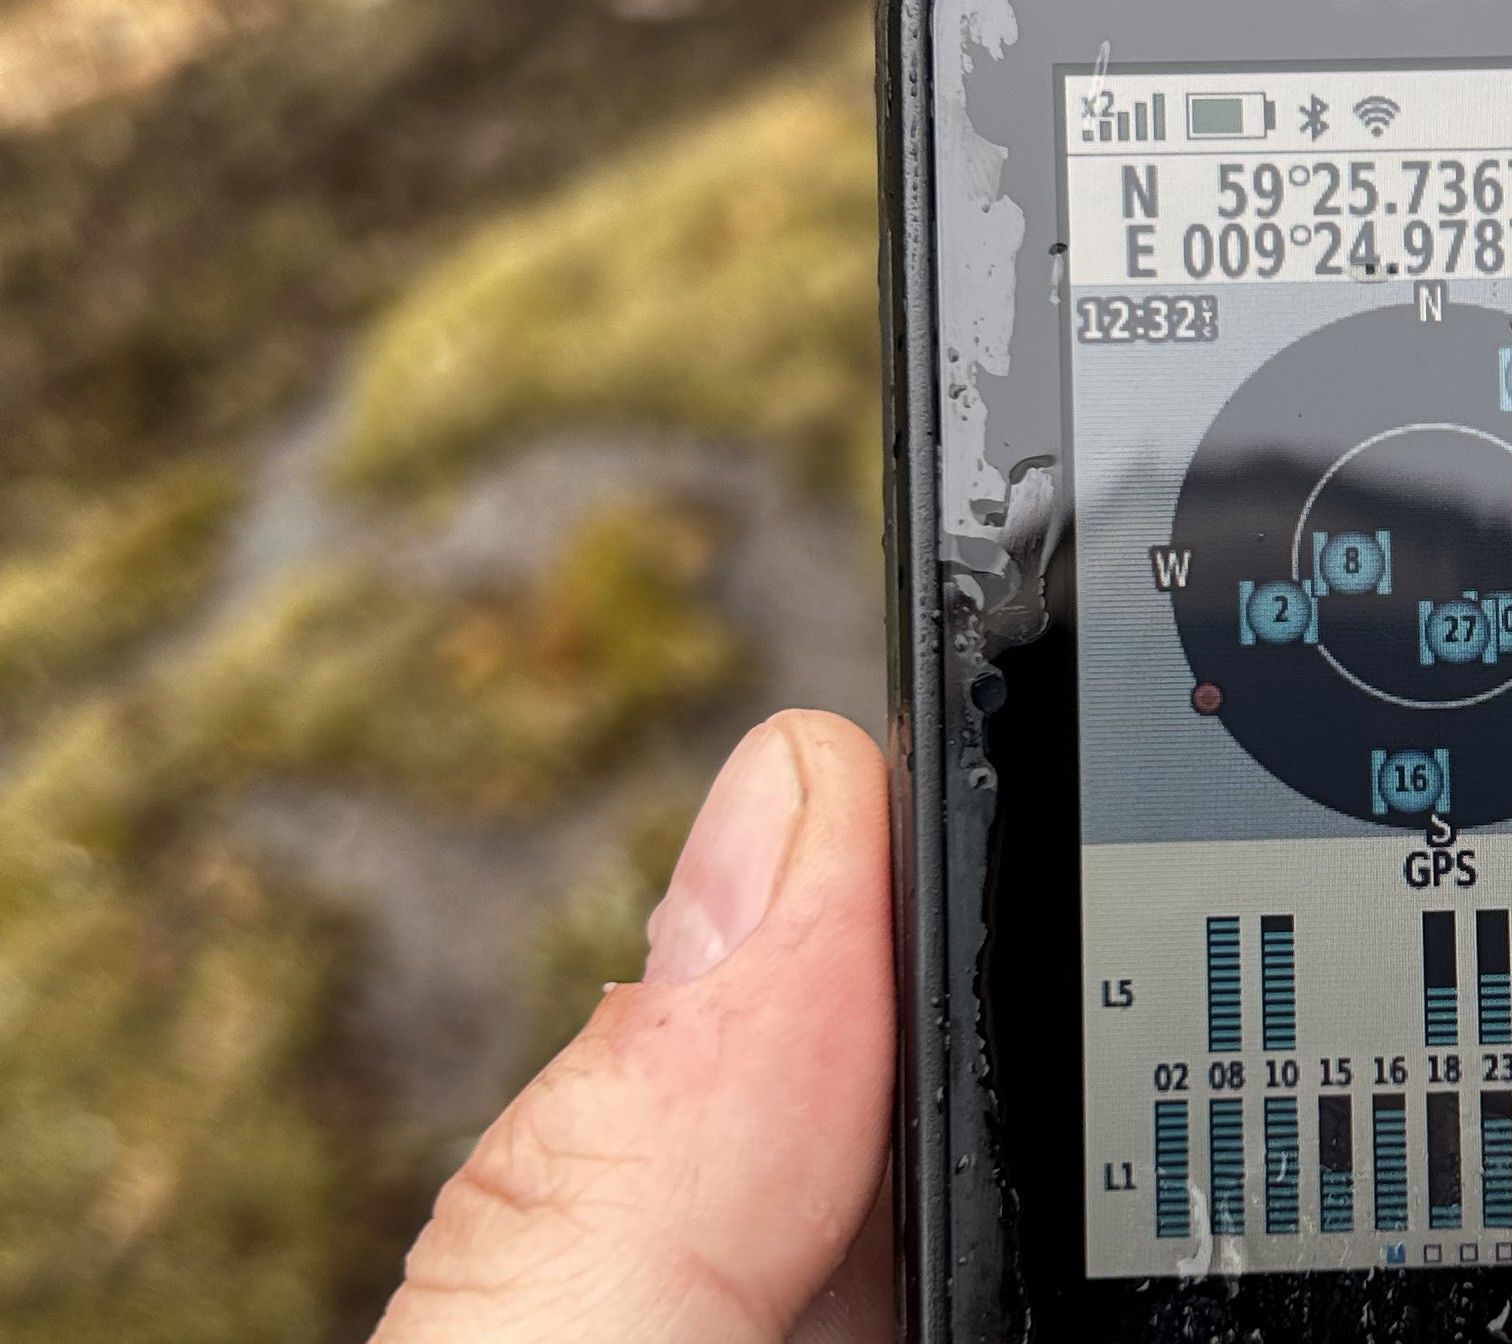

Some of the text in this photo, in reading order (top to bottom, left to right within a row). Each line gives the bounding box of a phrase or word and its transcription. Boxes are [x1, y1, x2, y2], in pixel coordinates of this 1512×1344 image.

[1121, 165, 1159, 219] N
[1126, 225, 1157, 278] E
[1419, 287, 1443, 321] N
[1158, 551, 1190, 587] W
[1344, 547, 1358, 573] 8
[1274, 597, 1288, 623] 2
[1444, 616, 1476, 642] 27
[1395, 764, 1426, 791] 16
[1405, 850, 1477, 887] GPS
[1104, 981, 1134, 1007] L5
[1155, 1064, 1188, 1091] 02
[1209, 1063, 1244, 1089] 08
[1266, 1061, 1298, 1087] 10
[1320, 1059, 1352, 1086] 15
[1374, 1058, 1406, 1084] 16
[1428, 1057, 1460, 1083] 18
[1105, 1164, 1136, 1190] L1
